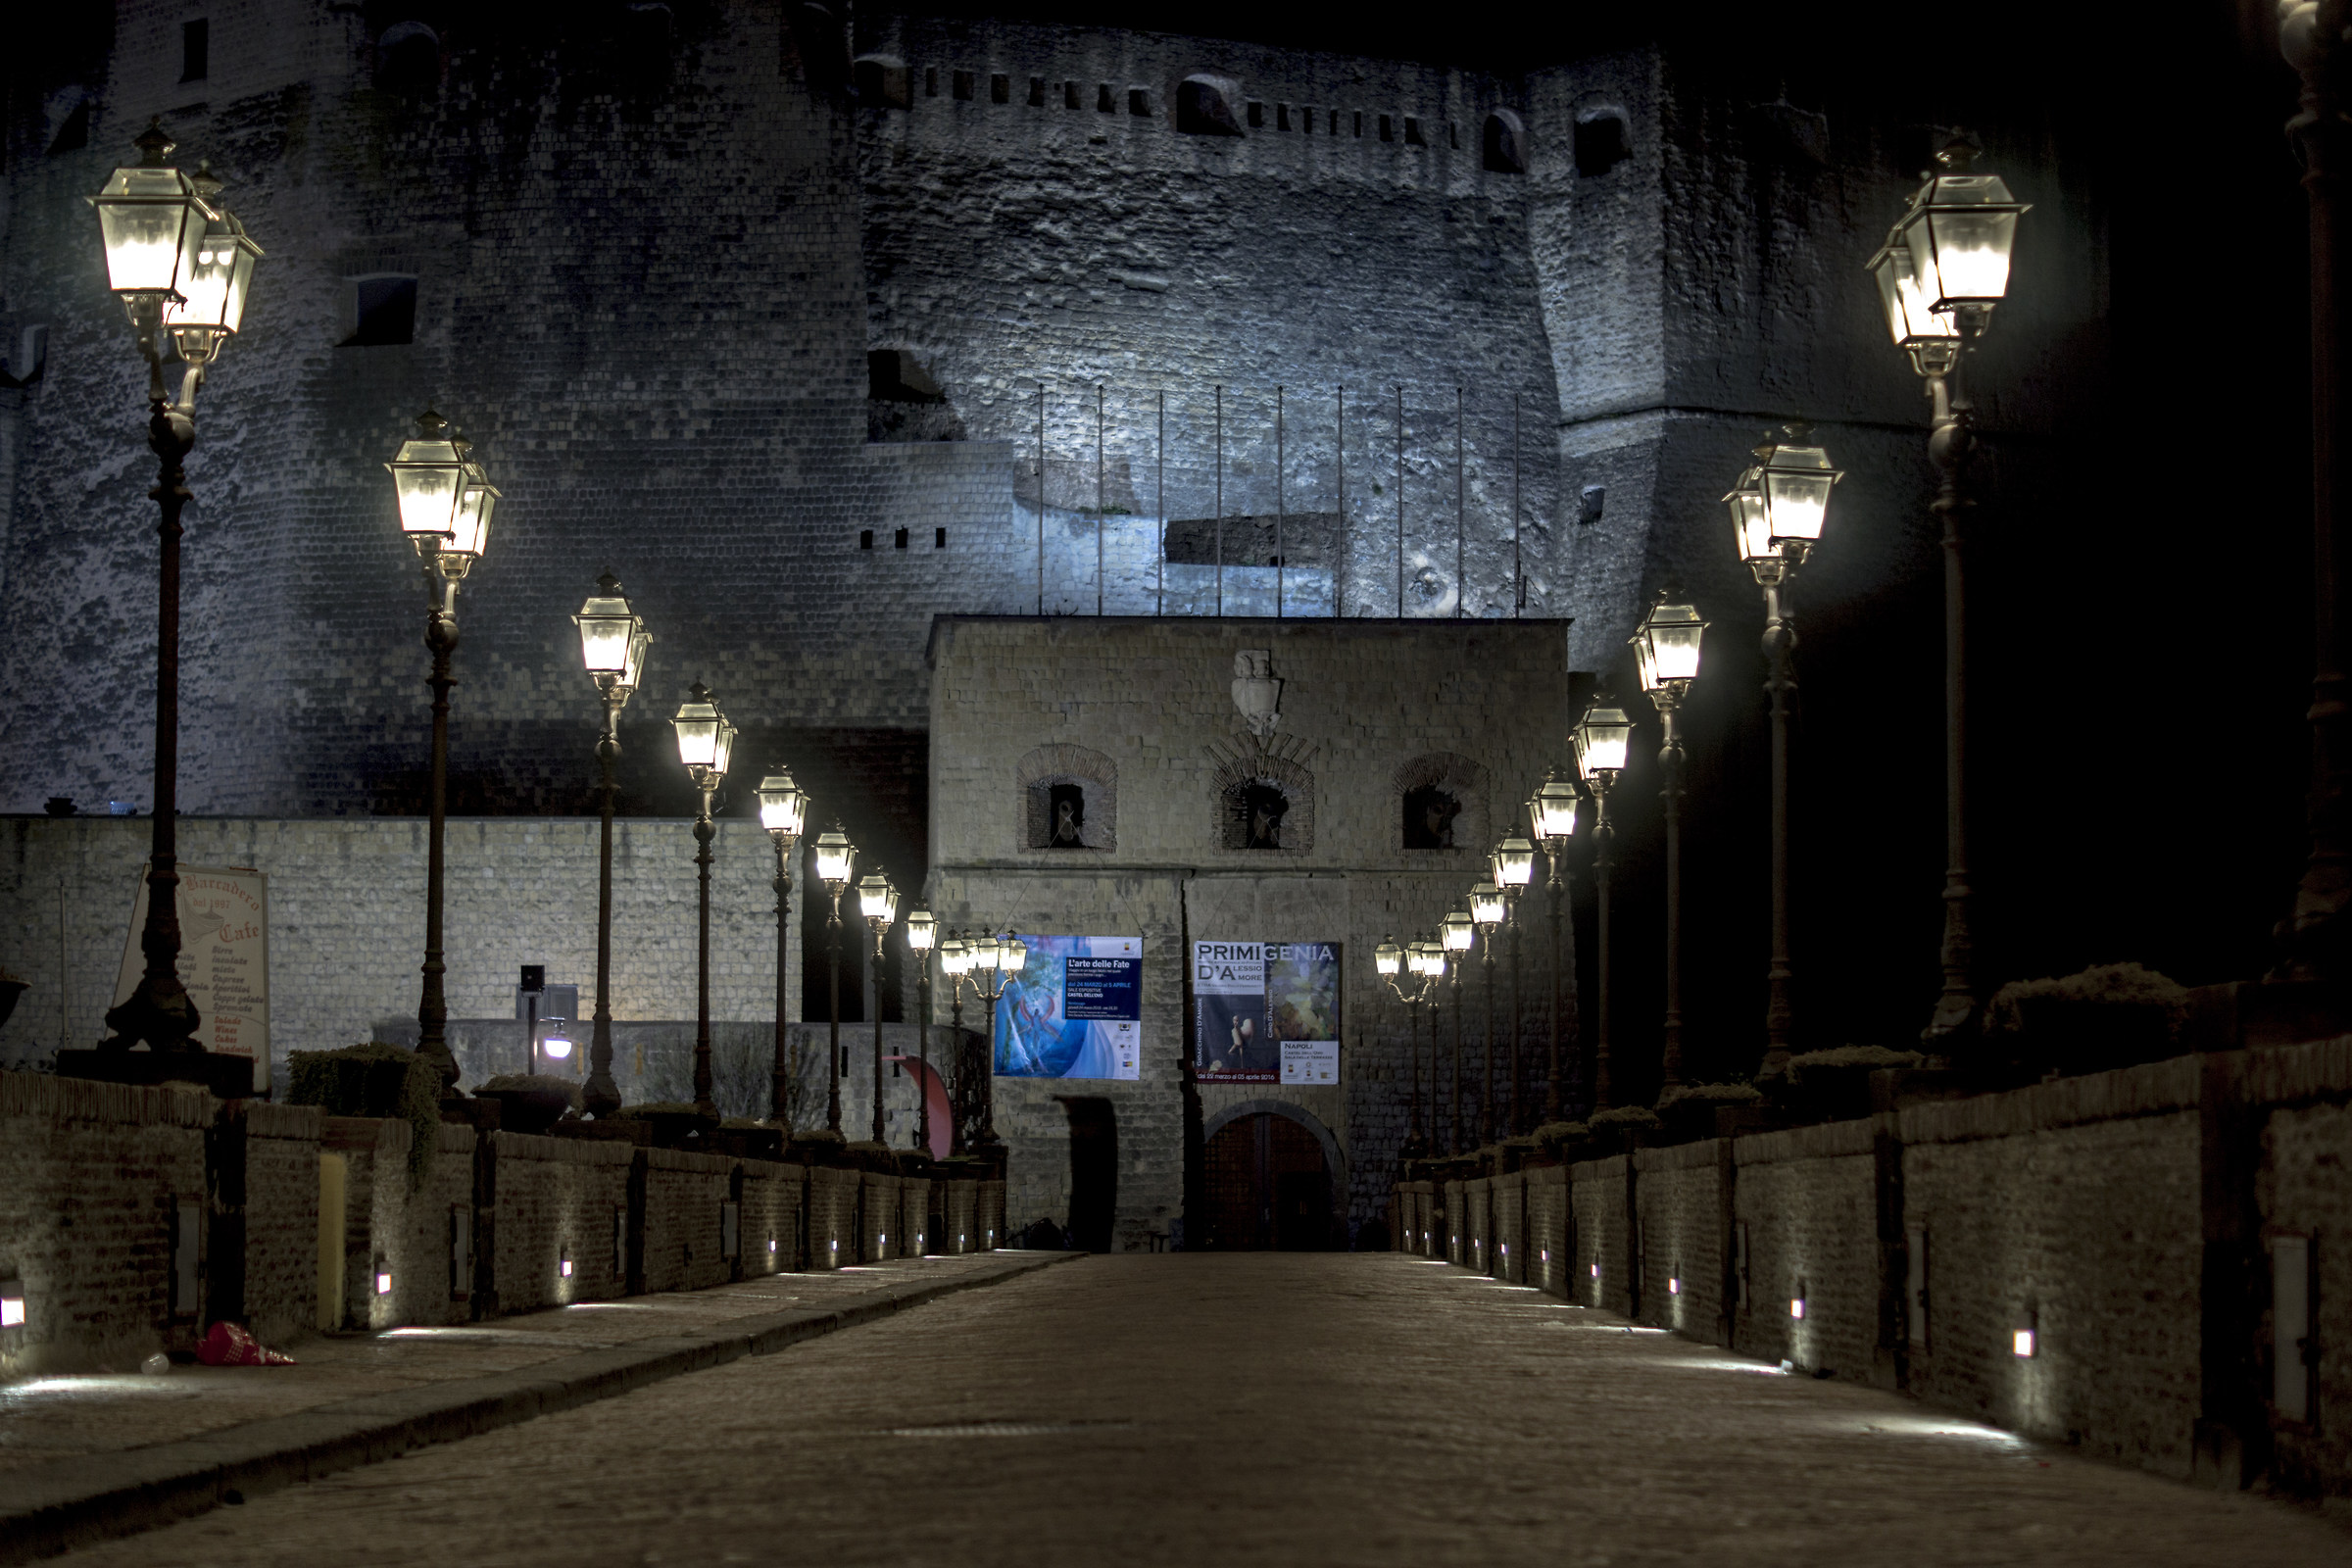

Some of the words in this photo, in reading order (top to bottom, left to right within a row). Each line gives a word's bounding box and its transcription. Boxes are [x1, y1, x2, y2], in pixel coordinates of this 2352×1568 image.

[183, 874, 259, 911] Barcadero
[193, 897, 206, 907] dal
[211, 899, 230, 908] 1997
[215, 1025, 237, 1034] Wines
